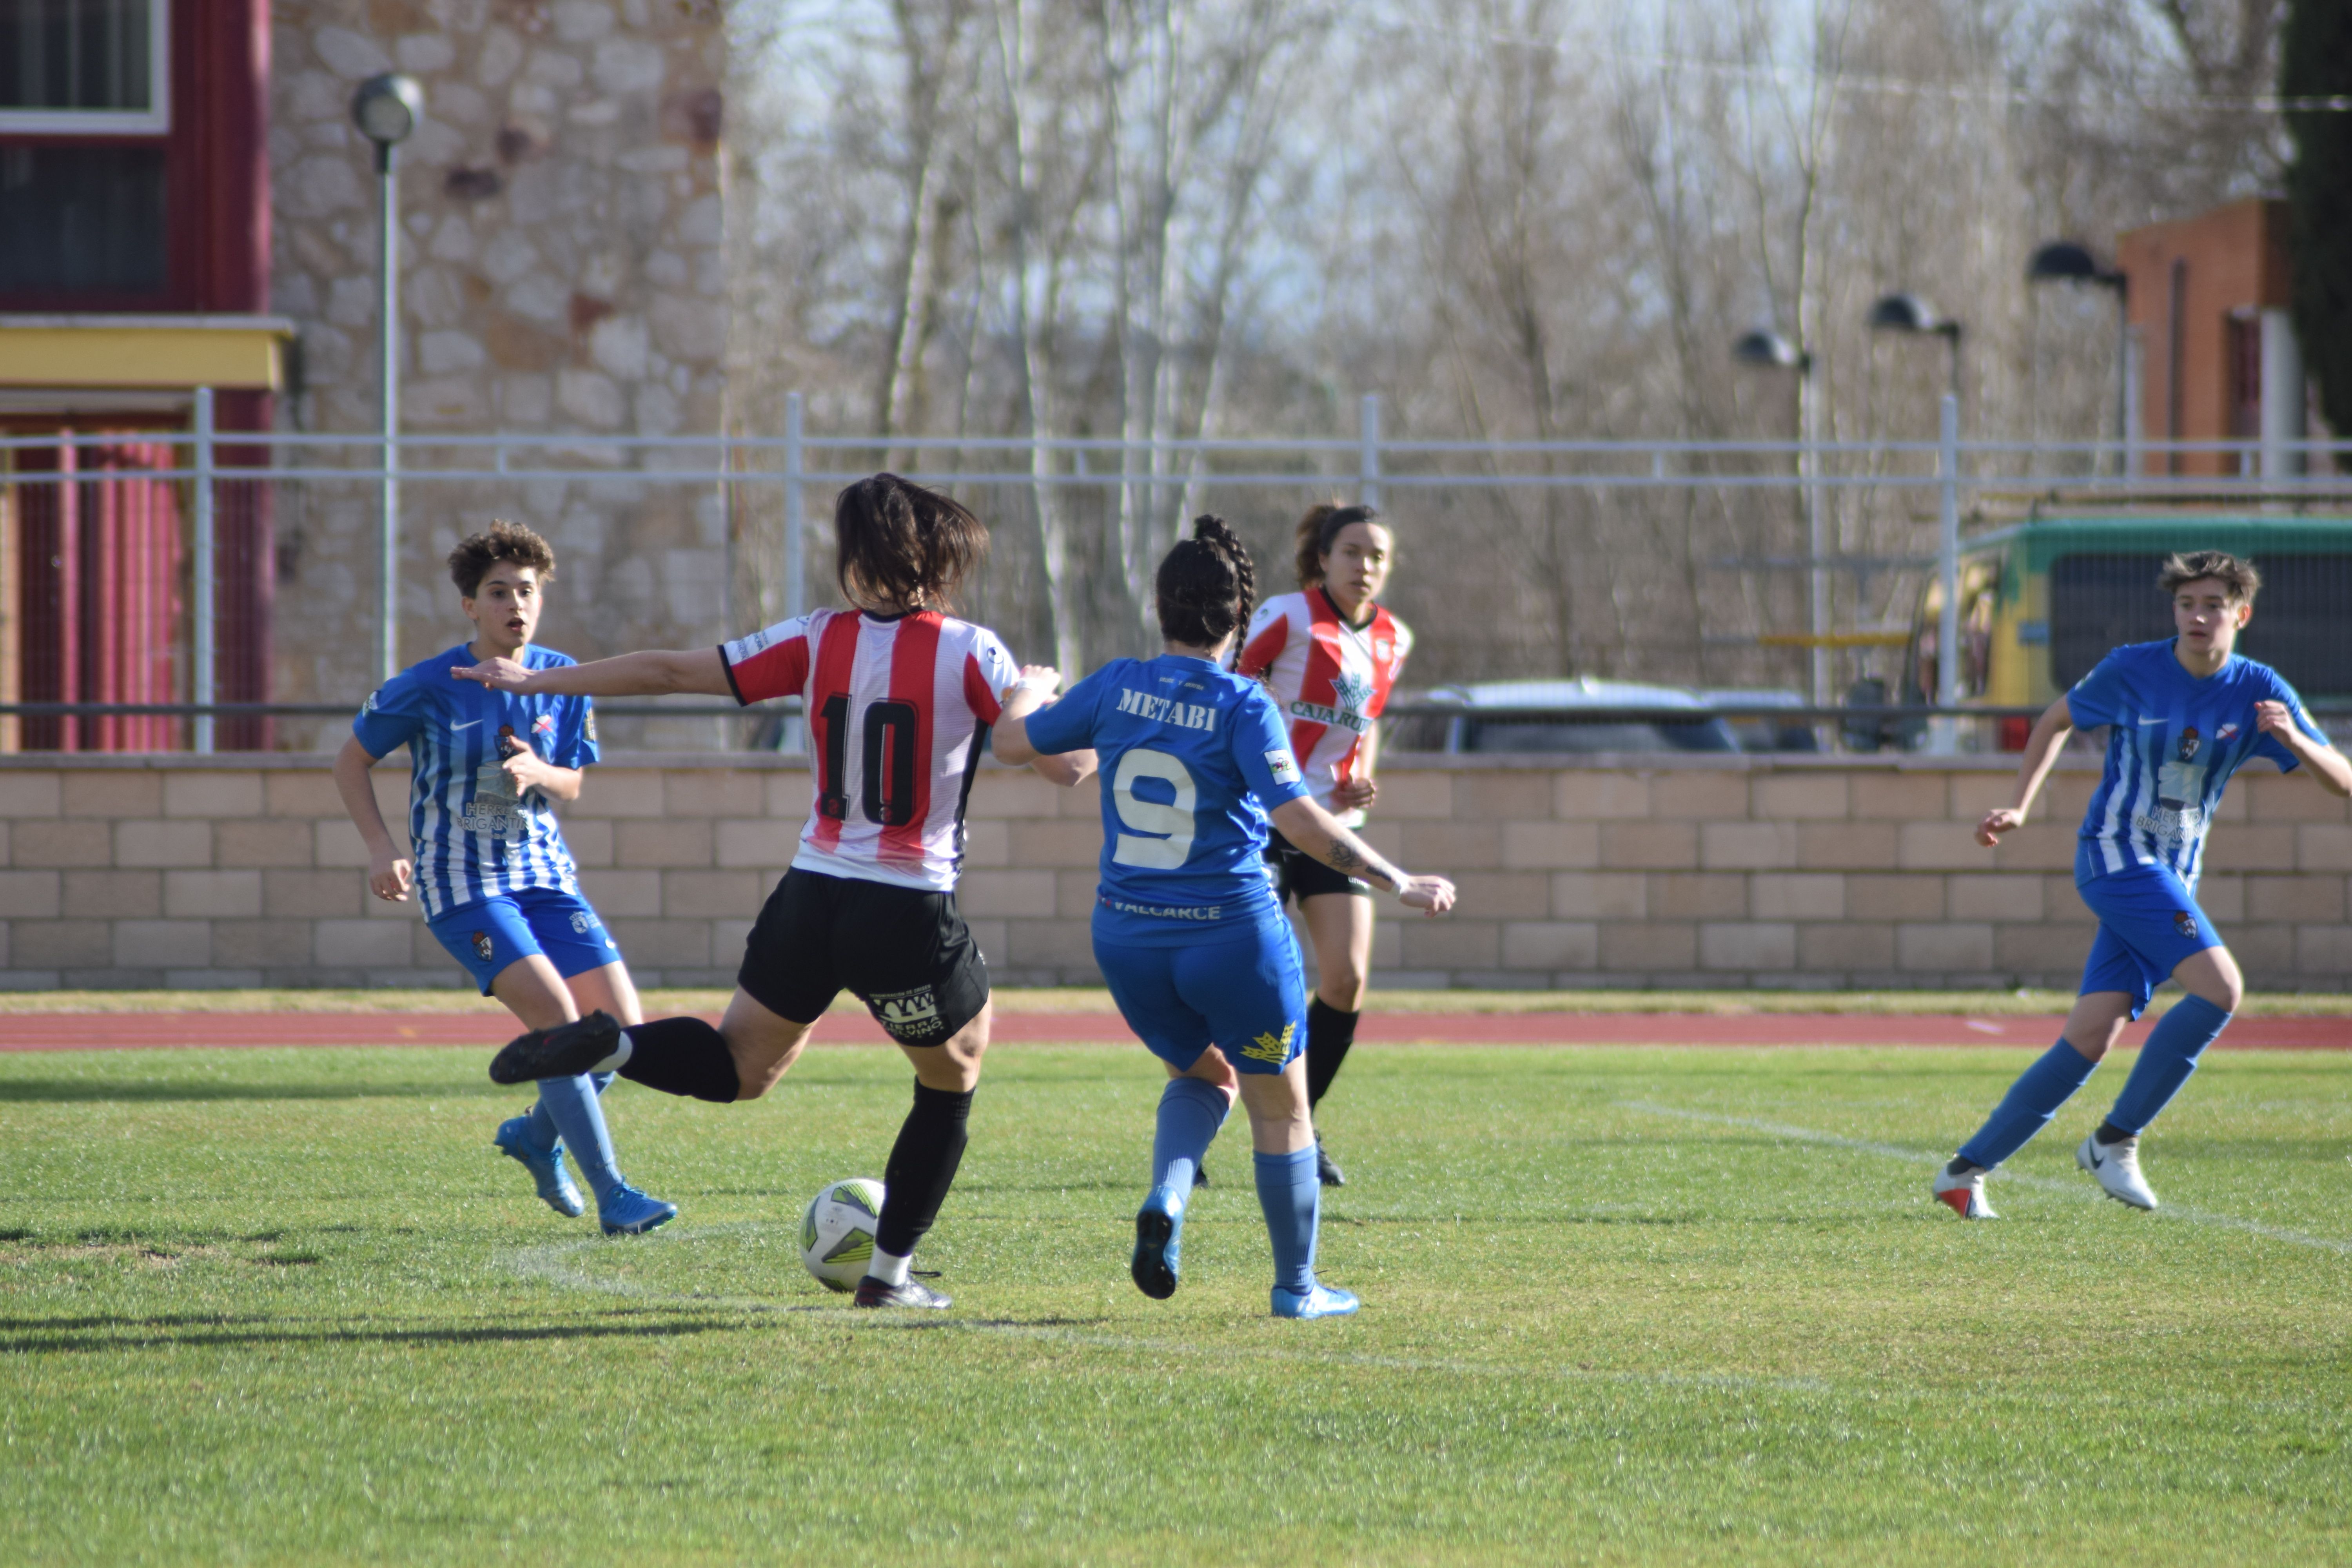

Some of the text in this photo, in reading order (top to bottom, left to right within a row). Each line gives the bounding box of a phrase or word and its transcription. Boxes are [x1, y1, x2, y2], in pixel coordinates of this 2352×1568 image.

[1116, 688, 1216, 731] METABI
[820, 692, 918, 826] 10
[1112, 748, 1196, 870] 9
[1114, 902, 1221, 920] VALCARCE
[913, 984, 931, 993] ORIGEN
